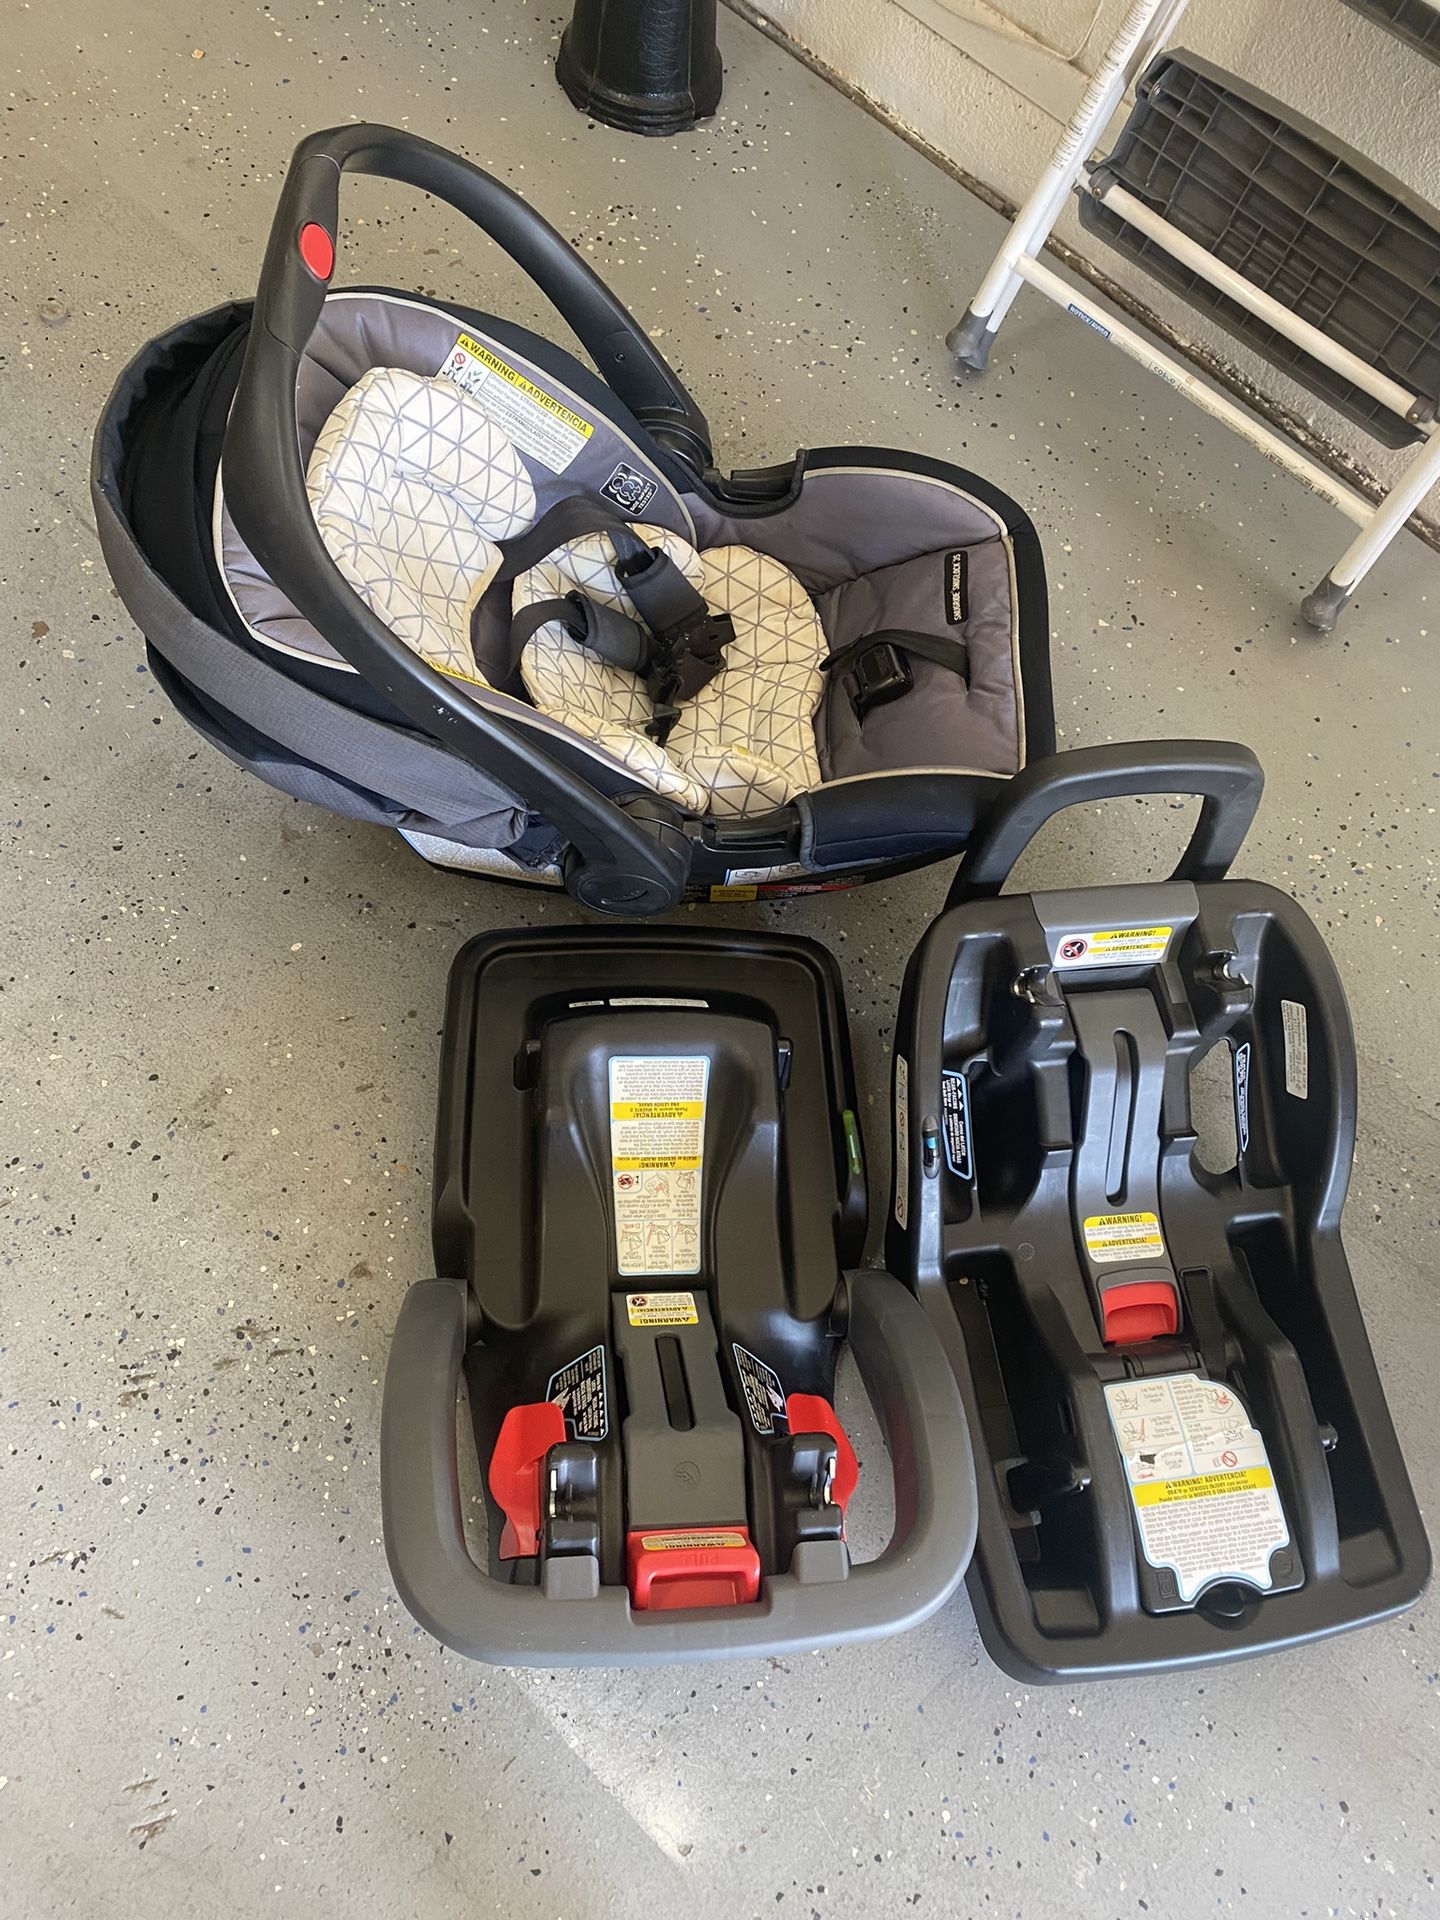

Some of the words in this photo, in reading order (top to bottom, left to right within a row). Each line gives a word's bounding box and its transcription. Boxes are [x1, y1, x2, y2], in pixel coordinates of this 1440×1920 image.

[467, 342, 516, 380] WARNING
[526, 385, 588, 432] ADVERTENCIA
[629, 500, 639, 511] SIDE
[637, 482, 651, 501] IMPACT
[1118, 930, 1156, 938] WARNING!
[1105, 1215, 1142, 1224] WARNING!
[1108, 1237, 1147, 1245] ADVERTENCIA!
[1172, 1477, 1203, 1487] WARNING!
[1204, 1470, 1246, 1483] ADVERTENCIA!
[679, 1553, 718, 1566] PULL
